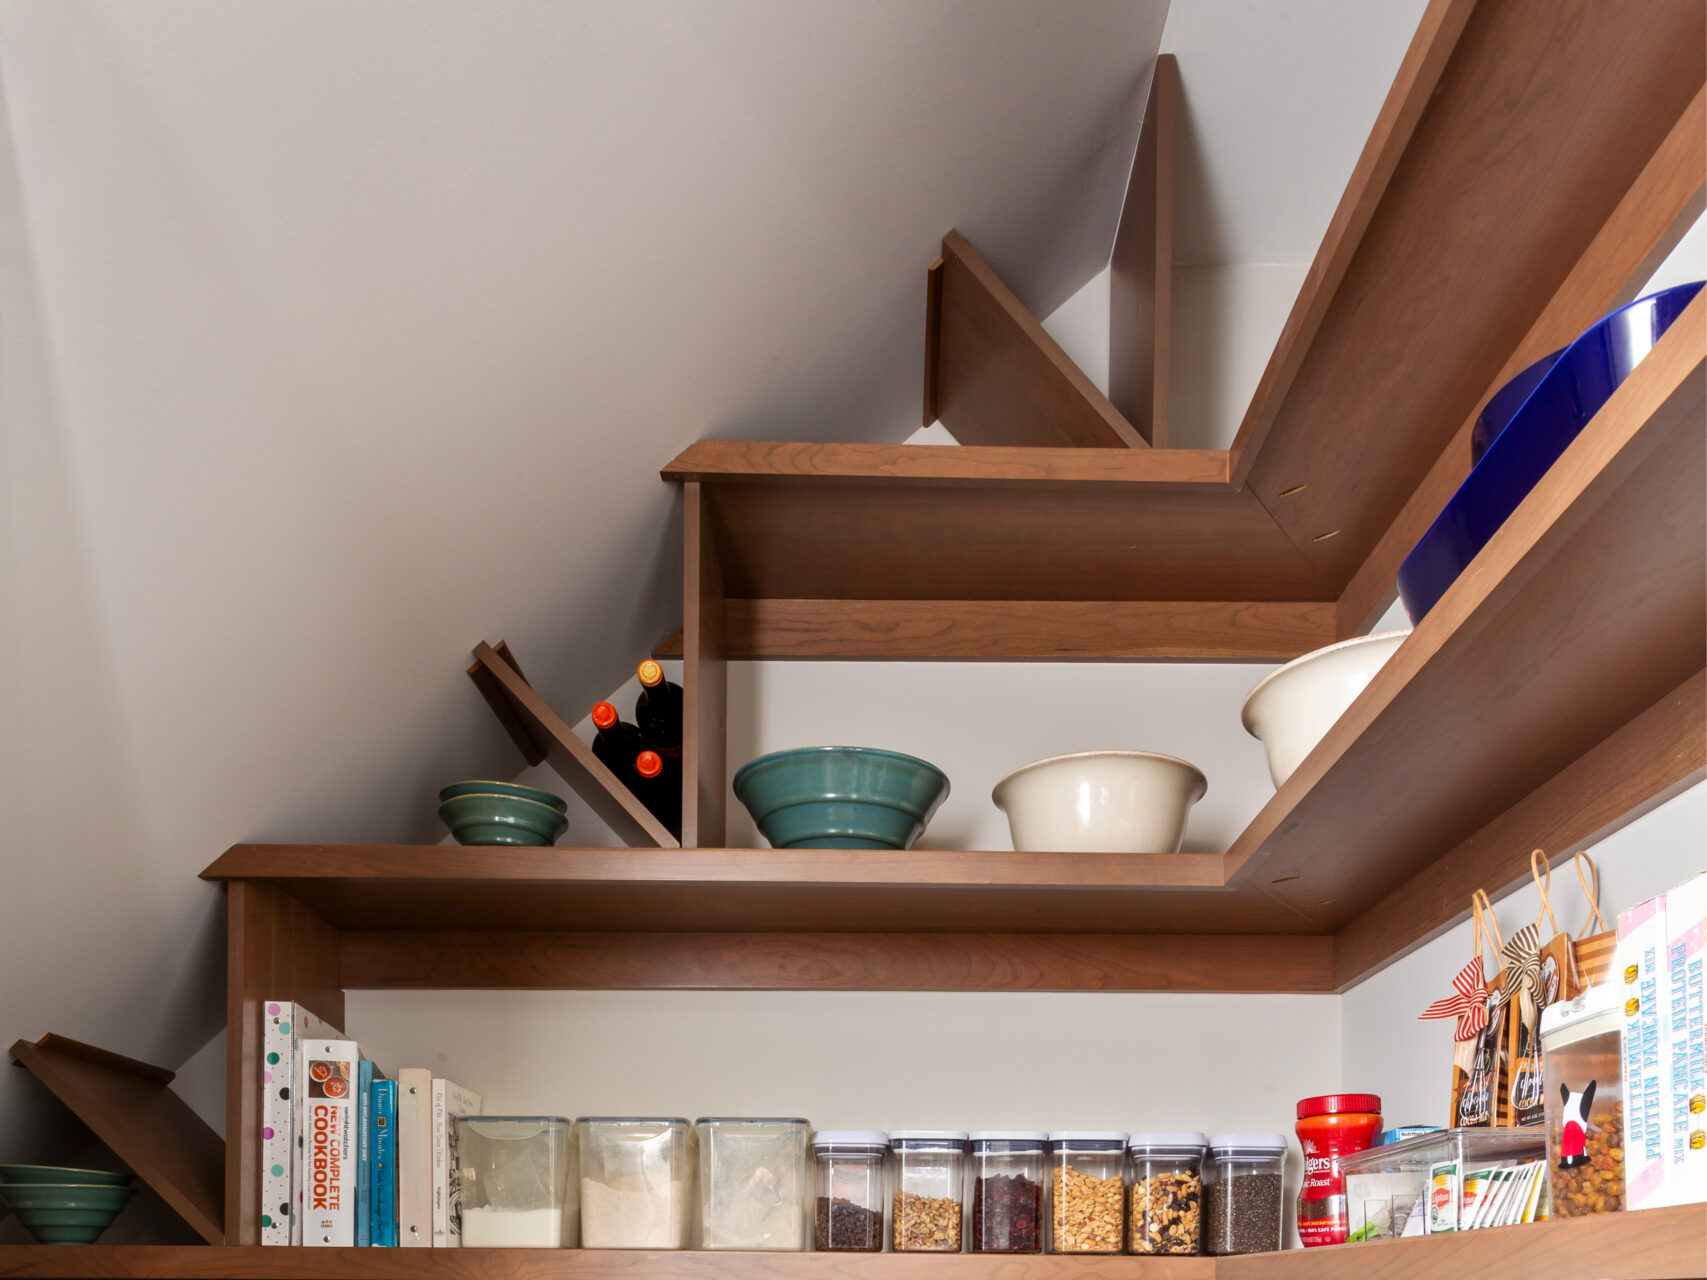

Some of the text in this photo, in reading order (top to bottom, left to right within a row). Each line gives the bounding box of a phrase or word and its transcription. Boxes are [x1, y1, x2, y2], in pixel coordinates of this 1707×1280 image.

[1640, 945, 1661, 1162] PROTEIN PANCAKE MIX
[1670, 942, 1689, 1165] PROTEIN PANCAKE MIX
[1687, 957, 1705, 1093] BUTTERMILK
[1626, 1018, 1643, 1143] BUTTERMILK
[312, 1104, 329, 1211] COOKBOOK
[328, 1104, 342, 1211] NEW COMPLETE
[1304, 1156, 1331, 1175] lgers
[1309, 1177, 1331, 1188] Roast
[1432, 1193, 1449, 1204] Lipton
